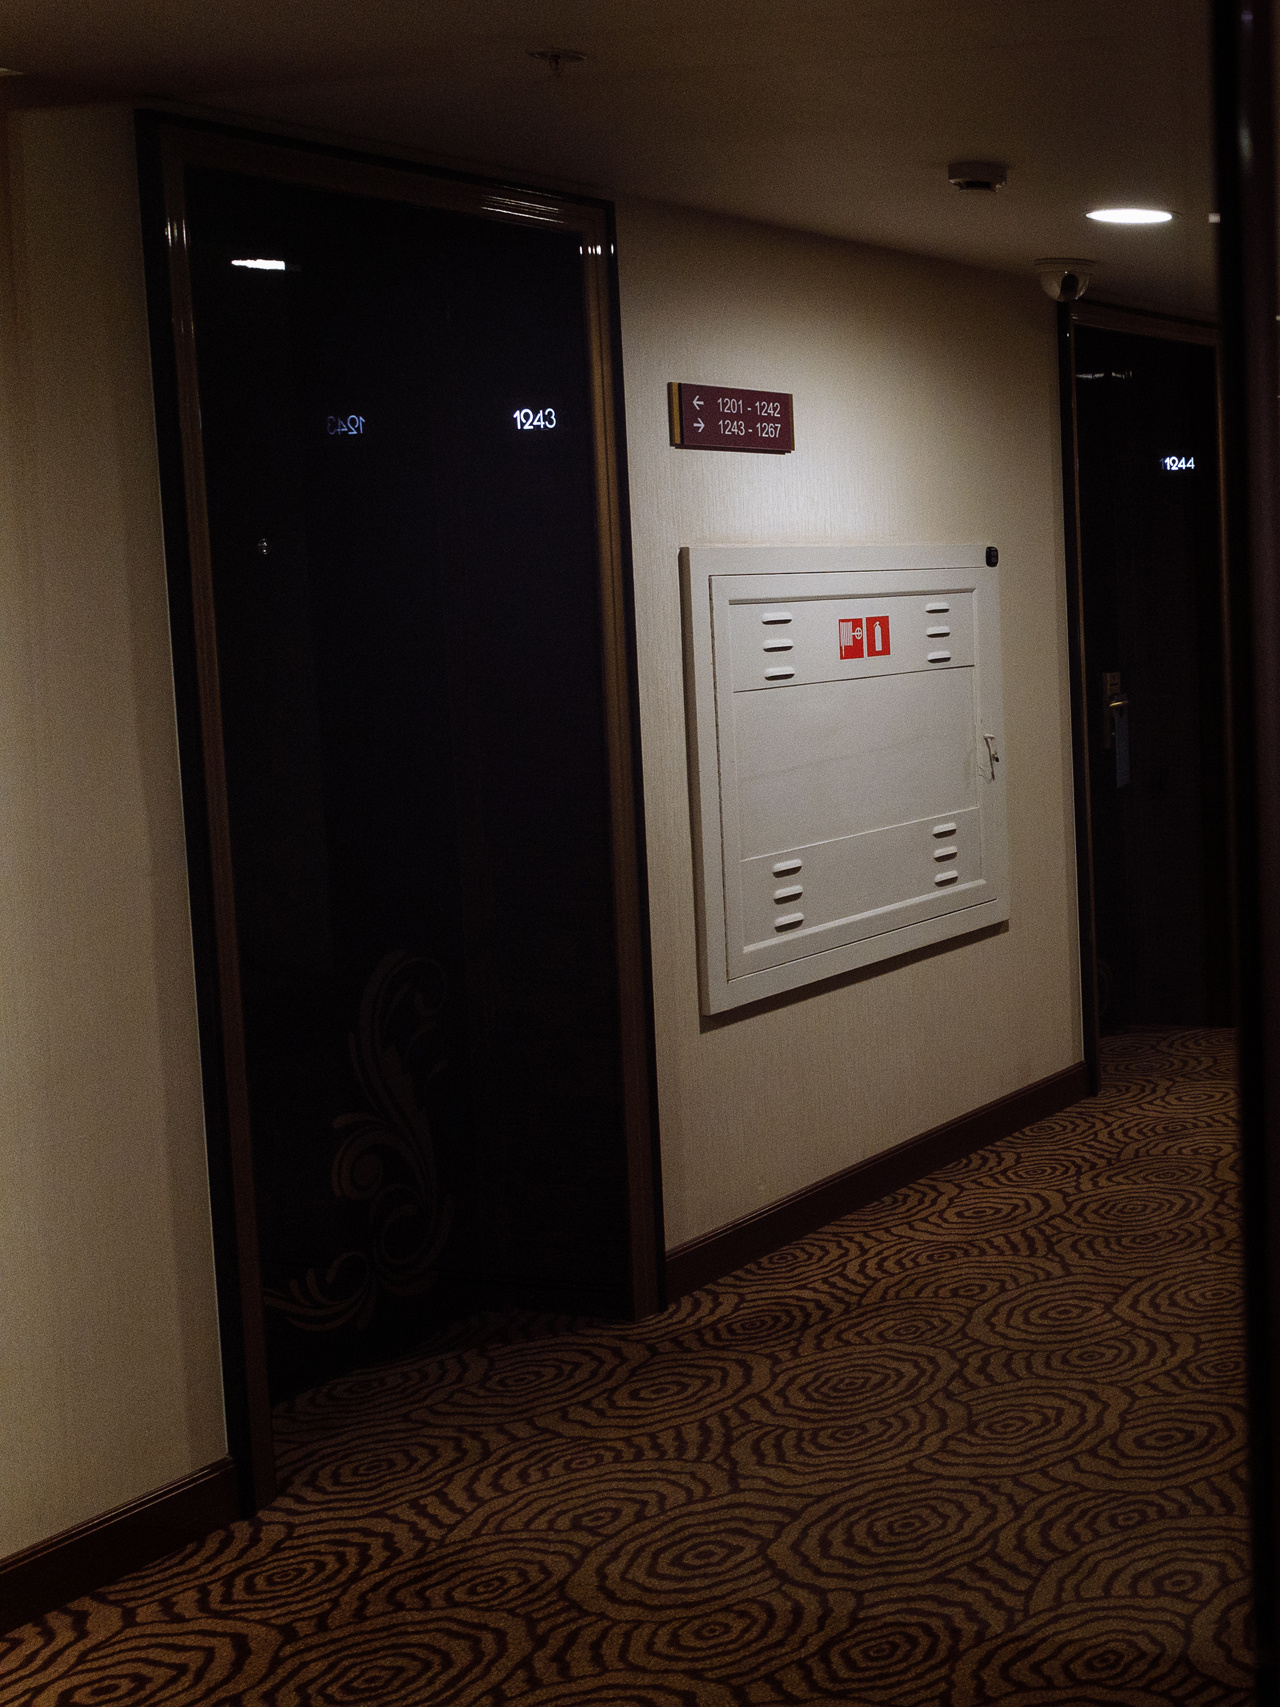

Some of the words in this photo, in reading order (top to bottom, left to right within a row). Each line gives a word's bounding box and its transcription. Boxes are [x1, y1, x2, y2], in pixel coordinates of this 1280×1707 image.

[717, 397, 743, 415] 1201
[755, 401, 781, 418] 1242
[512, 407, 557, 430] 1243
[718, 419, 745, 436] 1243
[756, 422, 781, 438] 1267
[1164, 455, 1196, 471] 1244
